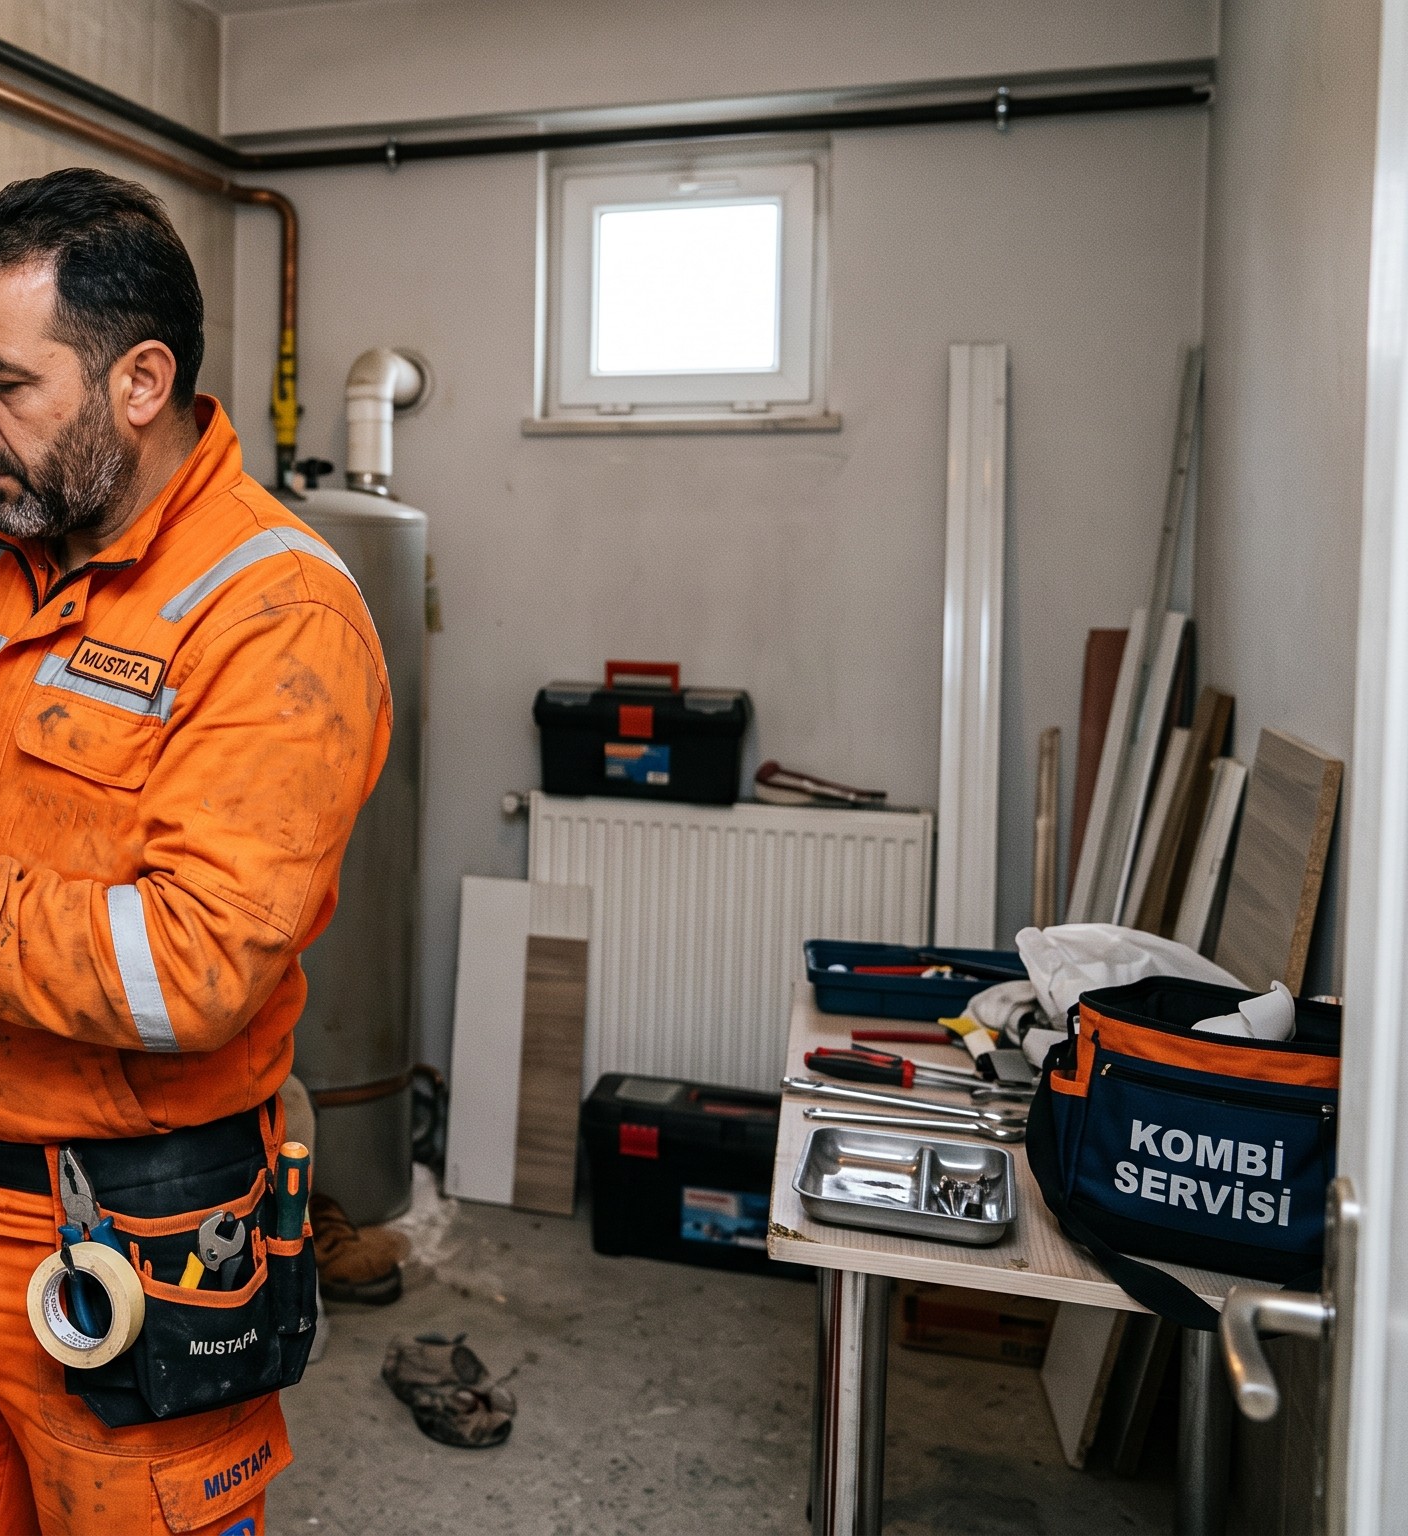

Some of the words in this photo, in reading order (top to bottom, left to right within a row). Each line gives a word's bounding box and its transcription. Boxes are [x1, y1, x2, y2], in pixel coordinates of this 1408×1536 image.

[79, 648, 150, 686] MUSTAFA
[1129, 1119, 1285, 1181] KOMBİ
[1114, 1160, 1292, 1227] SERVİSİ
[189, 1328, 258, 1355] MUSTAFA
[203, 1439, 272, 1501] MUSTAFA
